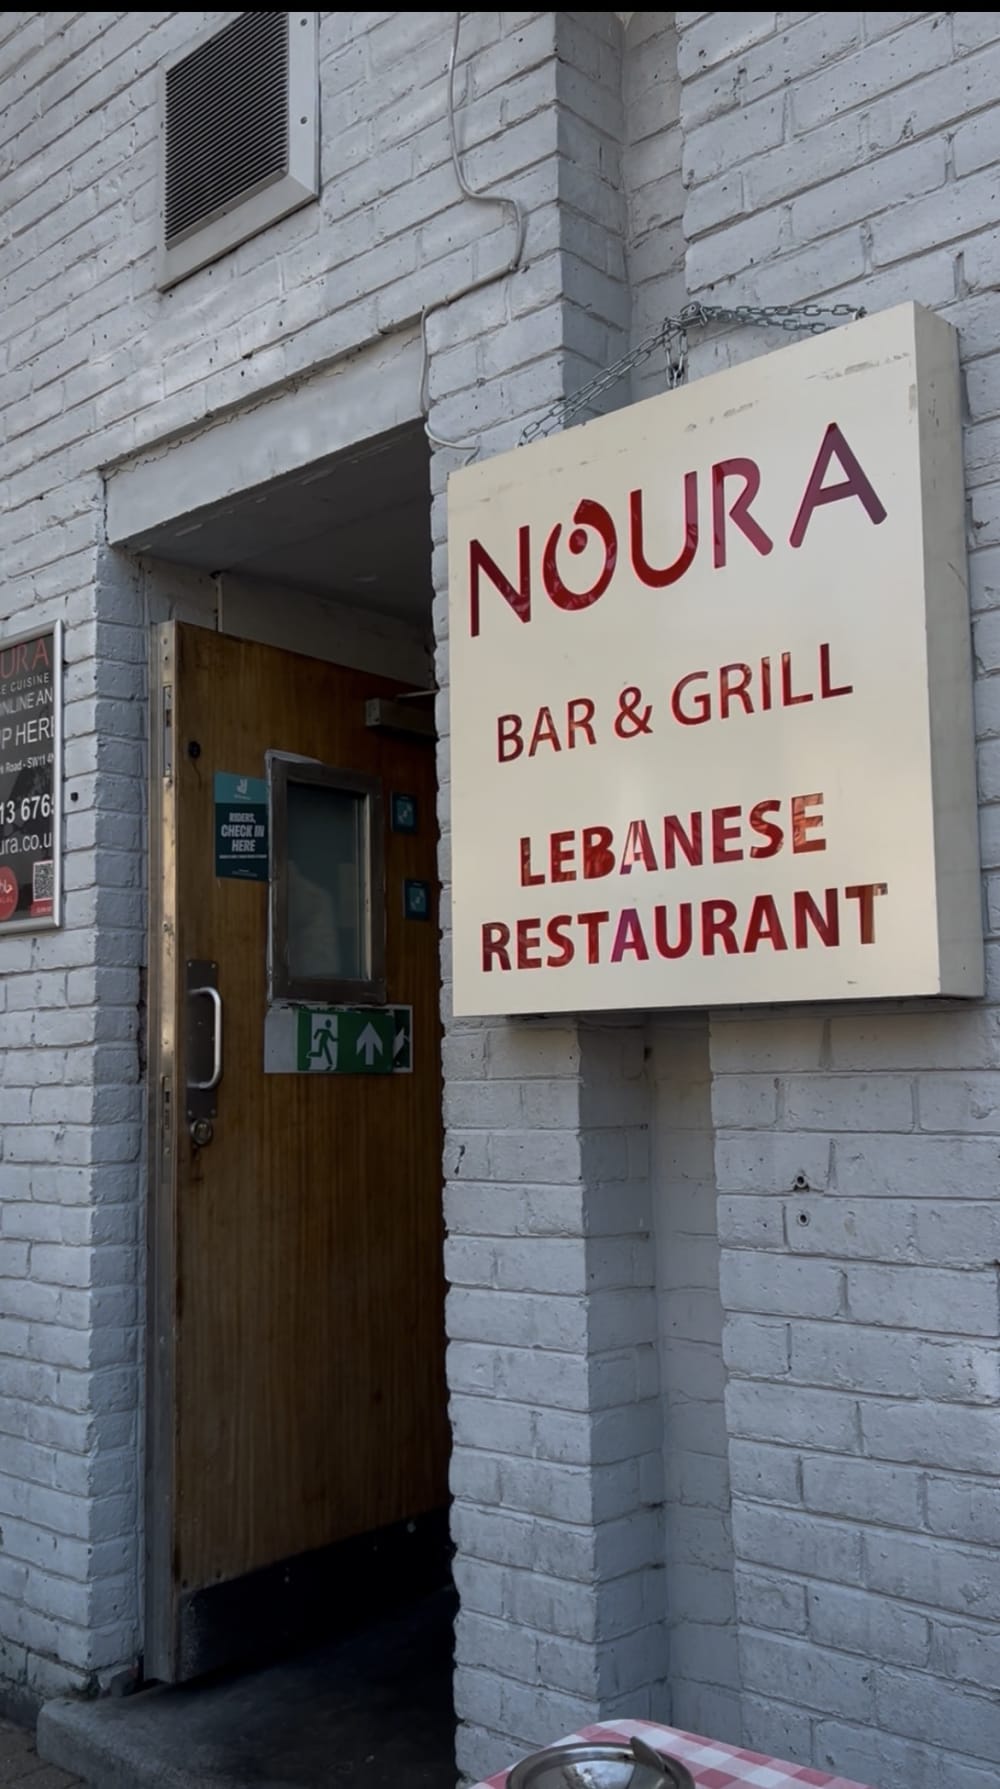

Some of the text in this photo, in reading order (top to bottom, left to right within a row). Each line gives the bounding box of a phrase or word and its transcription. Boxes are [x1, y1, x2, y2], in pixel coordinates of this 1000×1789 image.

[468, 421, 888, 637] NOURA
[10, 672, 49, 692] CUISINE
[497, 642, 854, 763] BAR & GRILL
[221, 824, 265, 837] CHECK IN
[231, 839, 256, 852] HERE
[519, 792, 828, 887] LEBANESE
[481, 882, 889, 973] RESTAURANT
